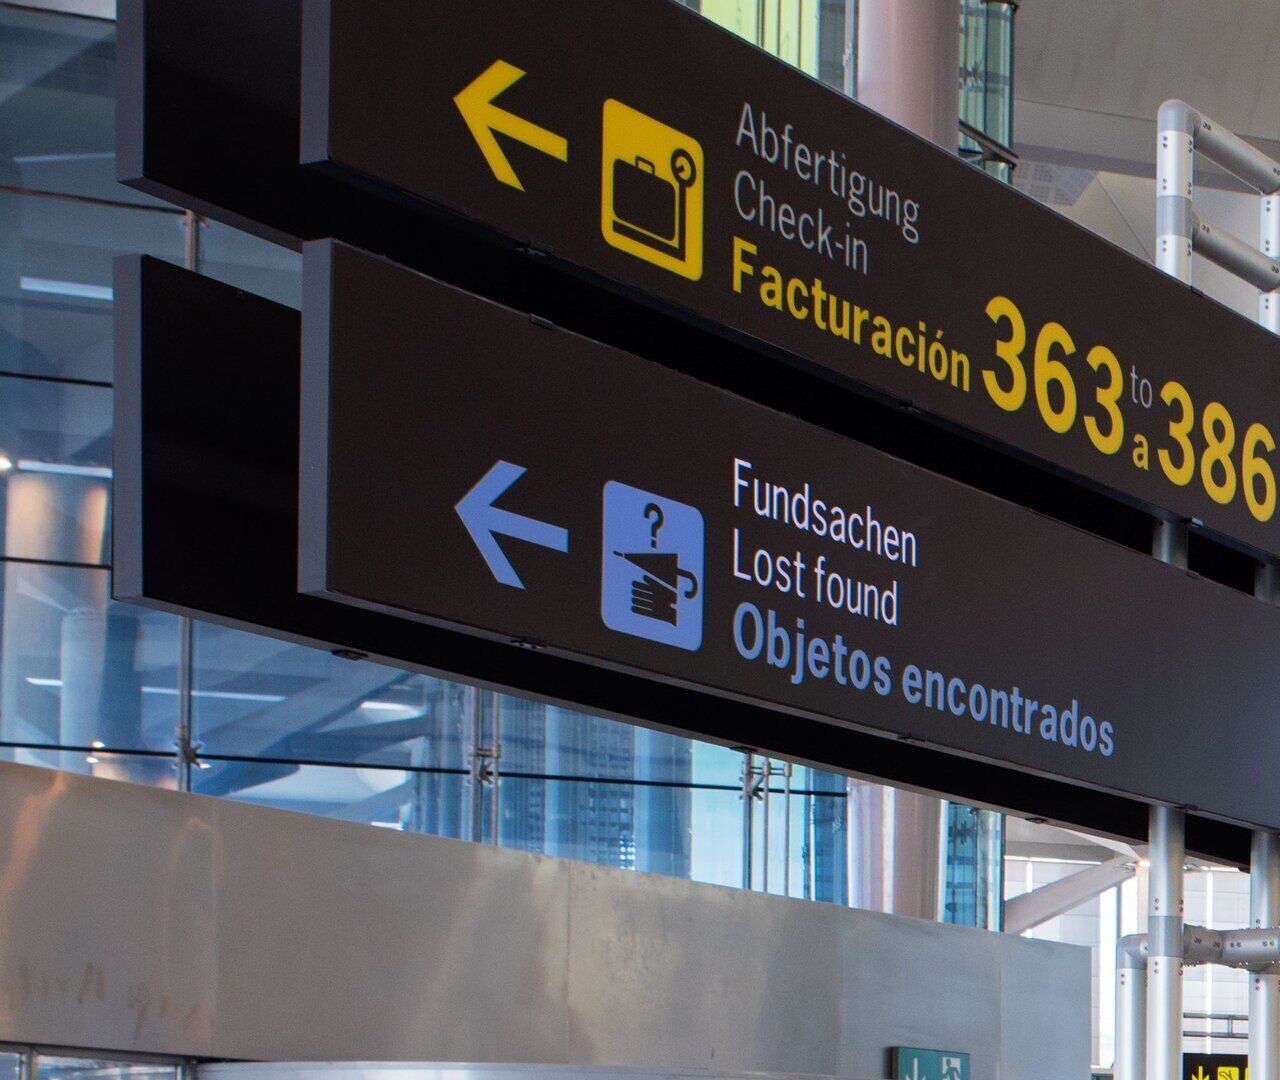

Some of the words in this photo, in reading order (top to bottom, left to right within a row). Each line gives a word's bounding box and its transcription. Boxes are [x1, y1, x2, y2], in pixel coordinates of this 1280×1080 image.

[734, 170, 869, 275] Check-in
[735, 102, 920, 245] Abfertigung
[733, 235, 970, 392] Facturación
[982, 296, 1125, 455] 363
[1130, 364, 1152, 409] to
[733, 457, 918, 567] Fundsachen
[1132, 433, 1150, 471] a
[1157, 381, 1277, 523] 386
[733, 528, 806, 599] Lost
[814, 555, 898, 626] found
[733, 601, 892, 696] Objetos
[902, 664, 1114, 757] encontrados
